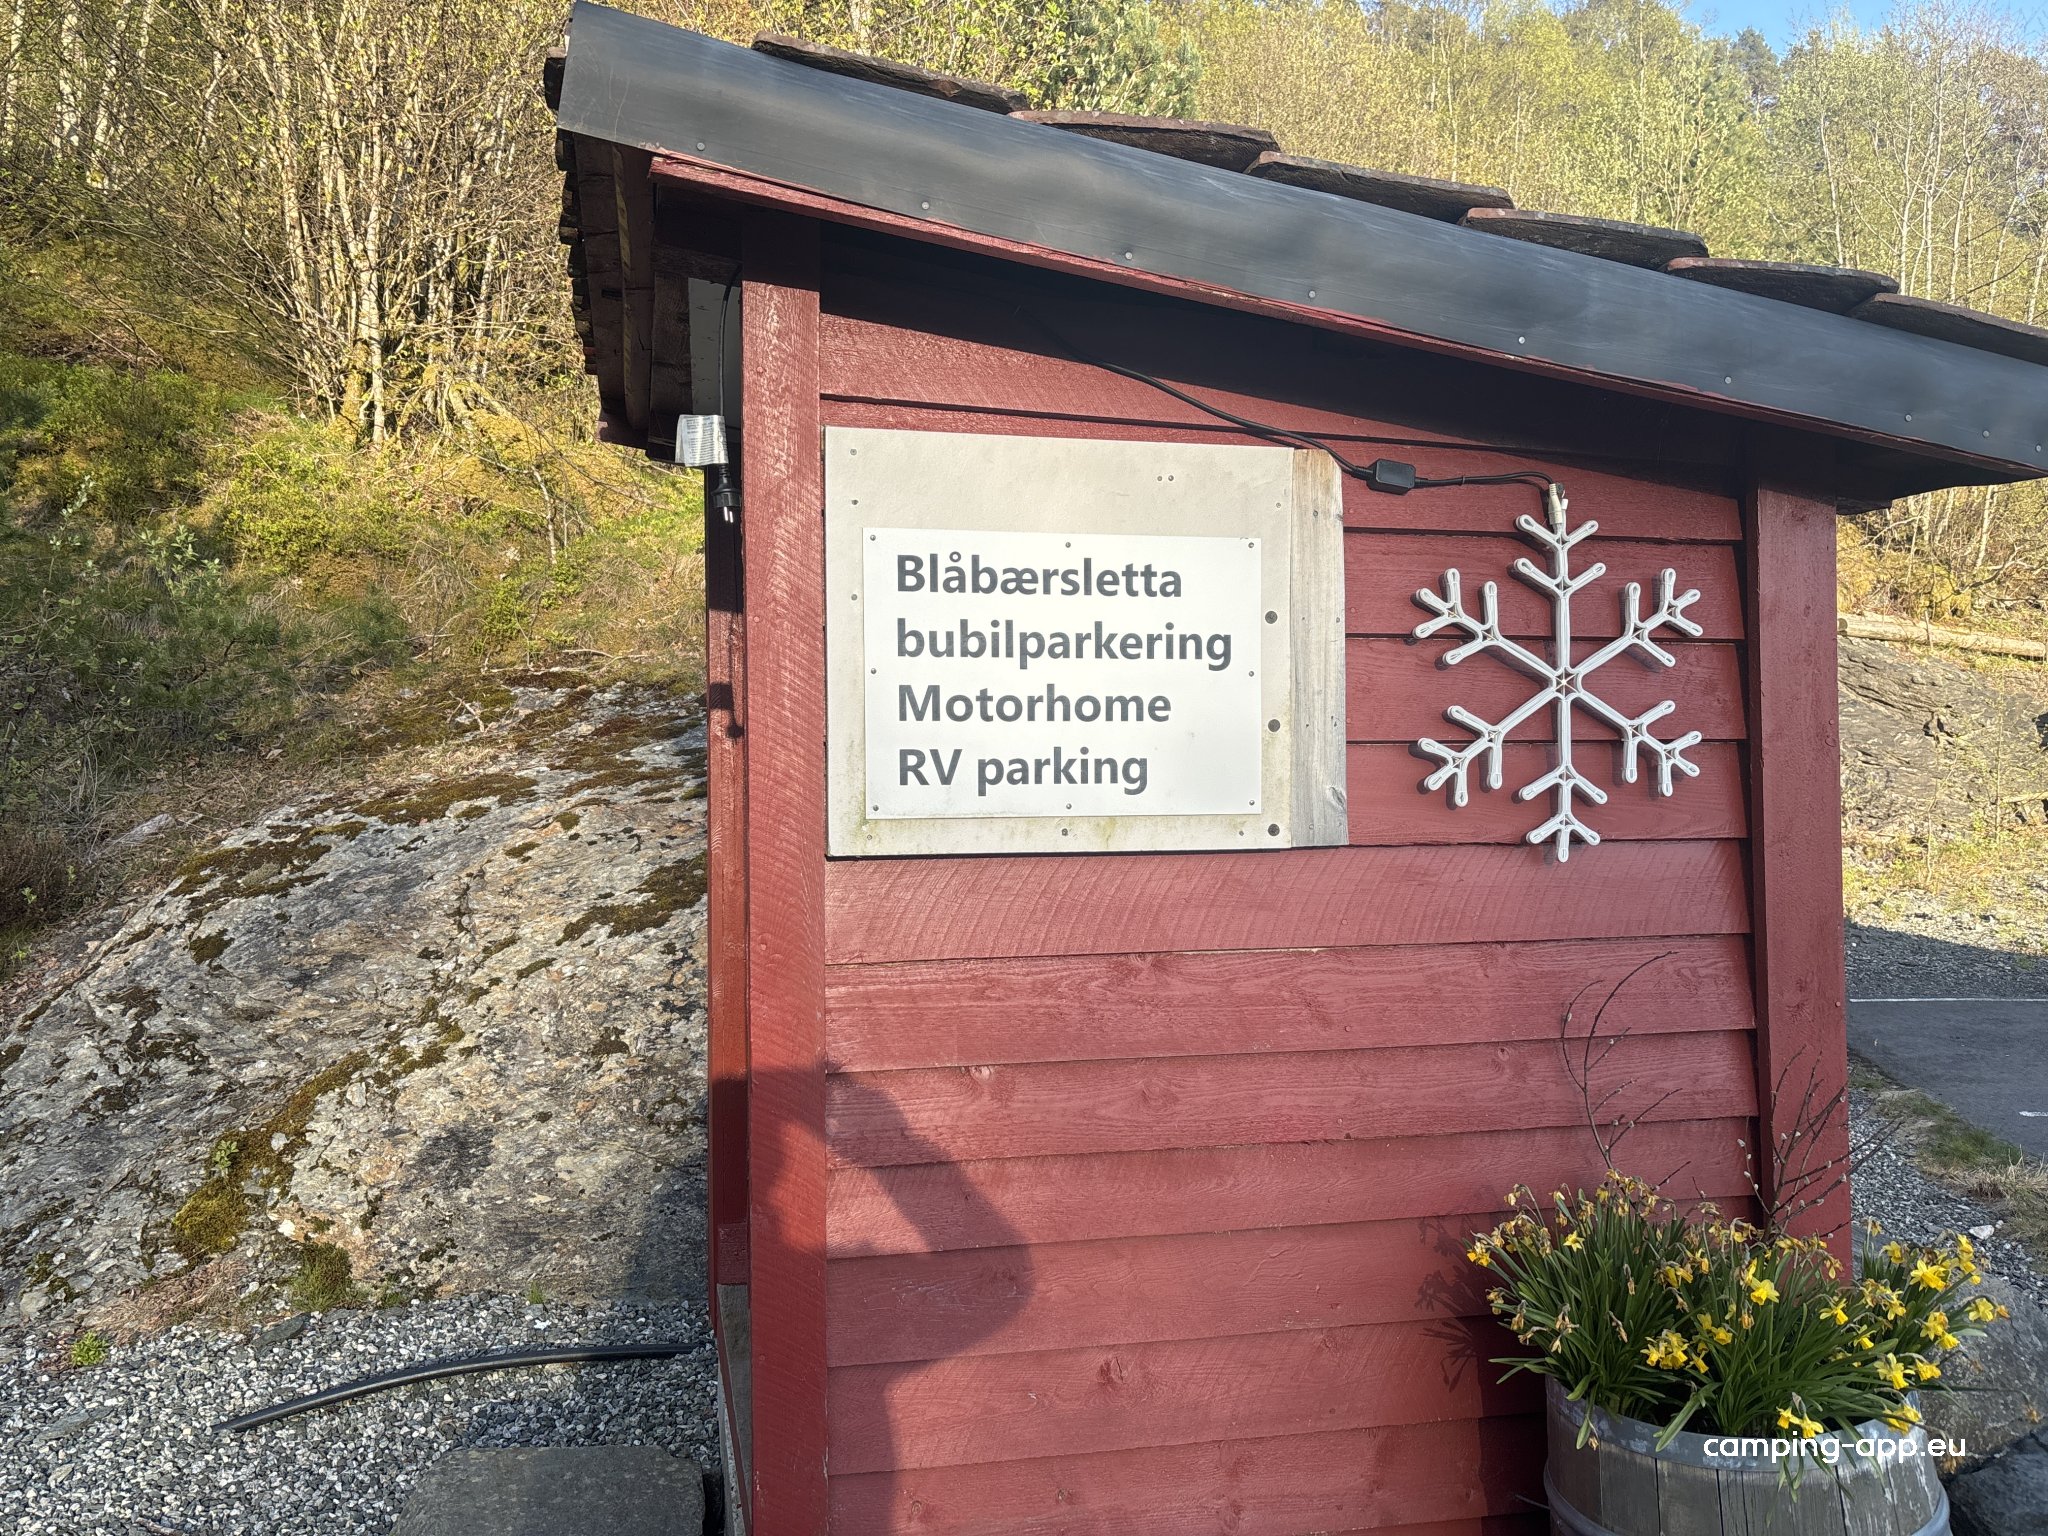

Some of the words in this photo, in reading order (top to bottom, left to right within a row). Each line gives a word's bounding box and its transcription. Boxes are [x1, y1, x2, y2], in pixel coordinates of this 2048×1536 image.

[897, 551, 1182, 598] Blåbærsletta
[897, 619, 1232, 672] bubilparkering
[898, 683, 1172, 722] Motorhome
[899, 748, 963, 786] RV
[977, 746, 1149, 797] parking
